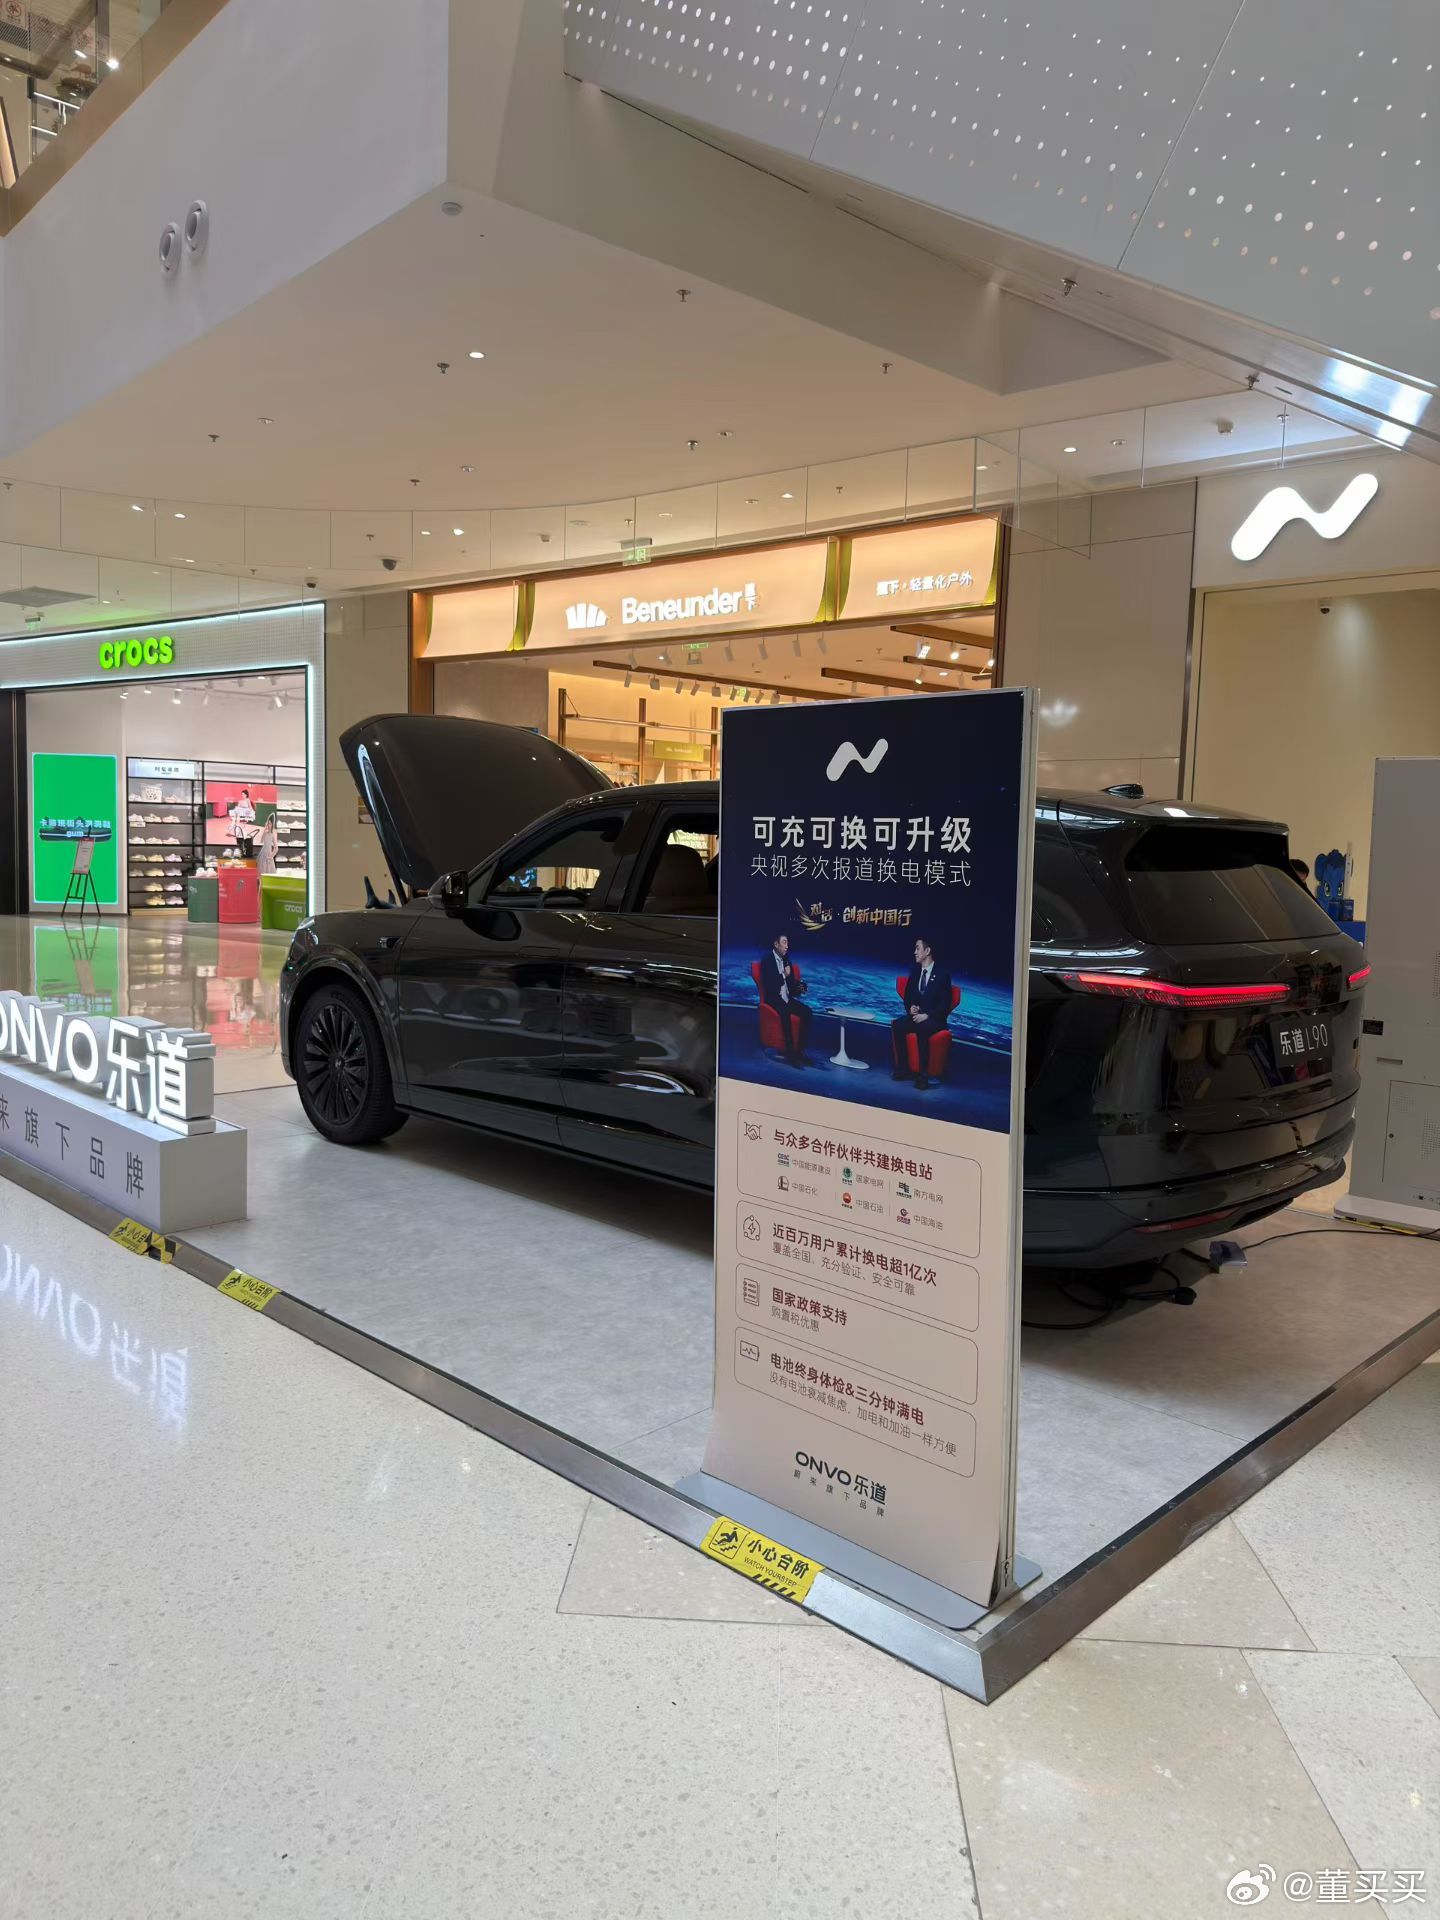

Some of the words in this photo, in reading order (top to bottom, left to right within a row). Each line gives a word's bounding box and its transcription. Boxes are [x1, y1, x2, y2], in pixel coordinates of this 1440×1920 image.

[622, 587, 743, 624] Beneunder
[99, 635, 175, 669] crocs
[752, 816, 972, 853] 可充可换可升级
[751, 853, 972, 887] 央视多次报道换电模式
[0, 998, 189, 1136] NVO乐道
[773, 1128, 933, 1181] 与众多合作伙伴共建换电站
[791, 1181, 818, 1197] 中国石化
[855, 1173, 885, 1189] 国家电网
[913, 1188, 944, 1205] 南方电网
[772, 1223, 937, 1287] 近百万用户累计换电超1亿次
[771, 1305, 820, 1332] 购置税优惠
[772, 1287, 848, 1326] 国家政策支持
[770, 1352, 924, 1426] 电池终身体检&三分钟满电
[743, 1556, 766, 1572] WATCH
[747, 1538, 810, 1580] 小心台阶
